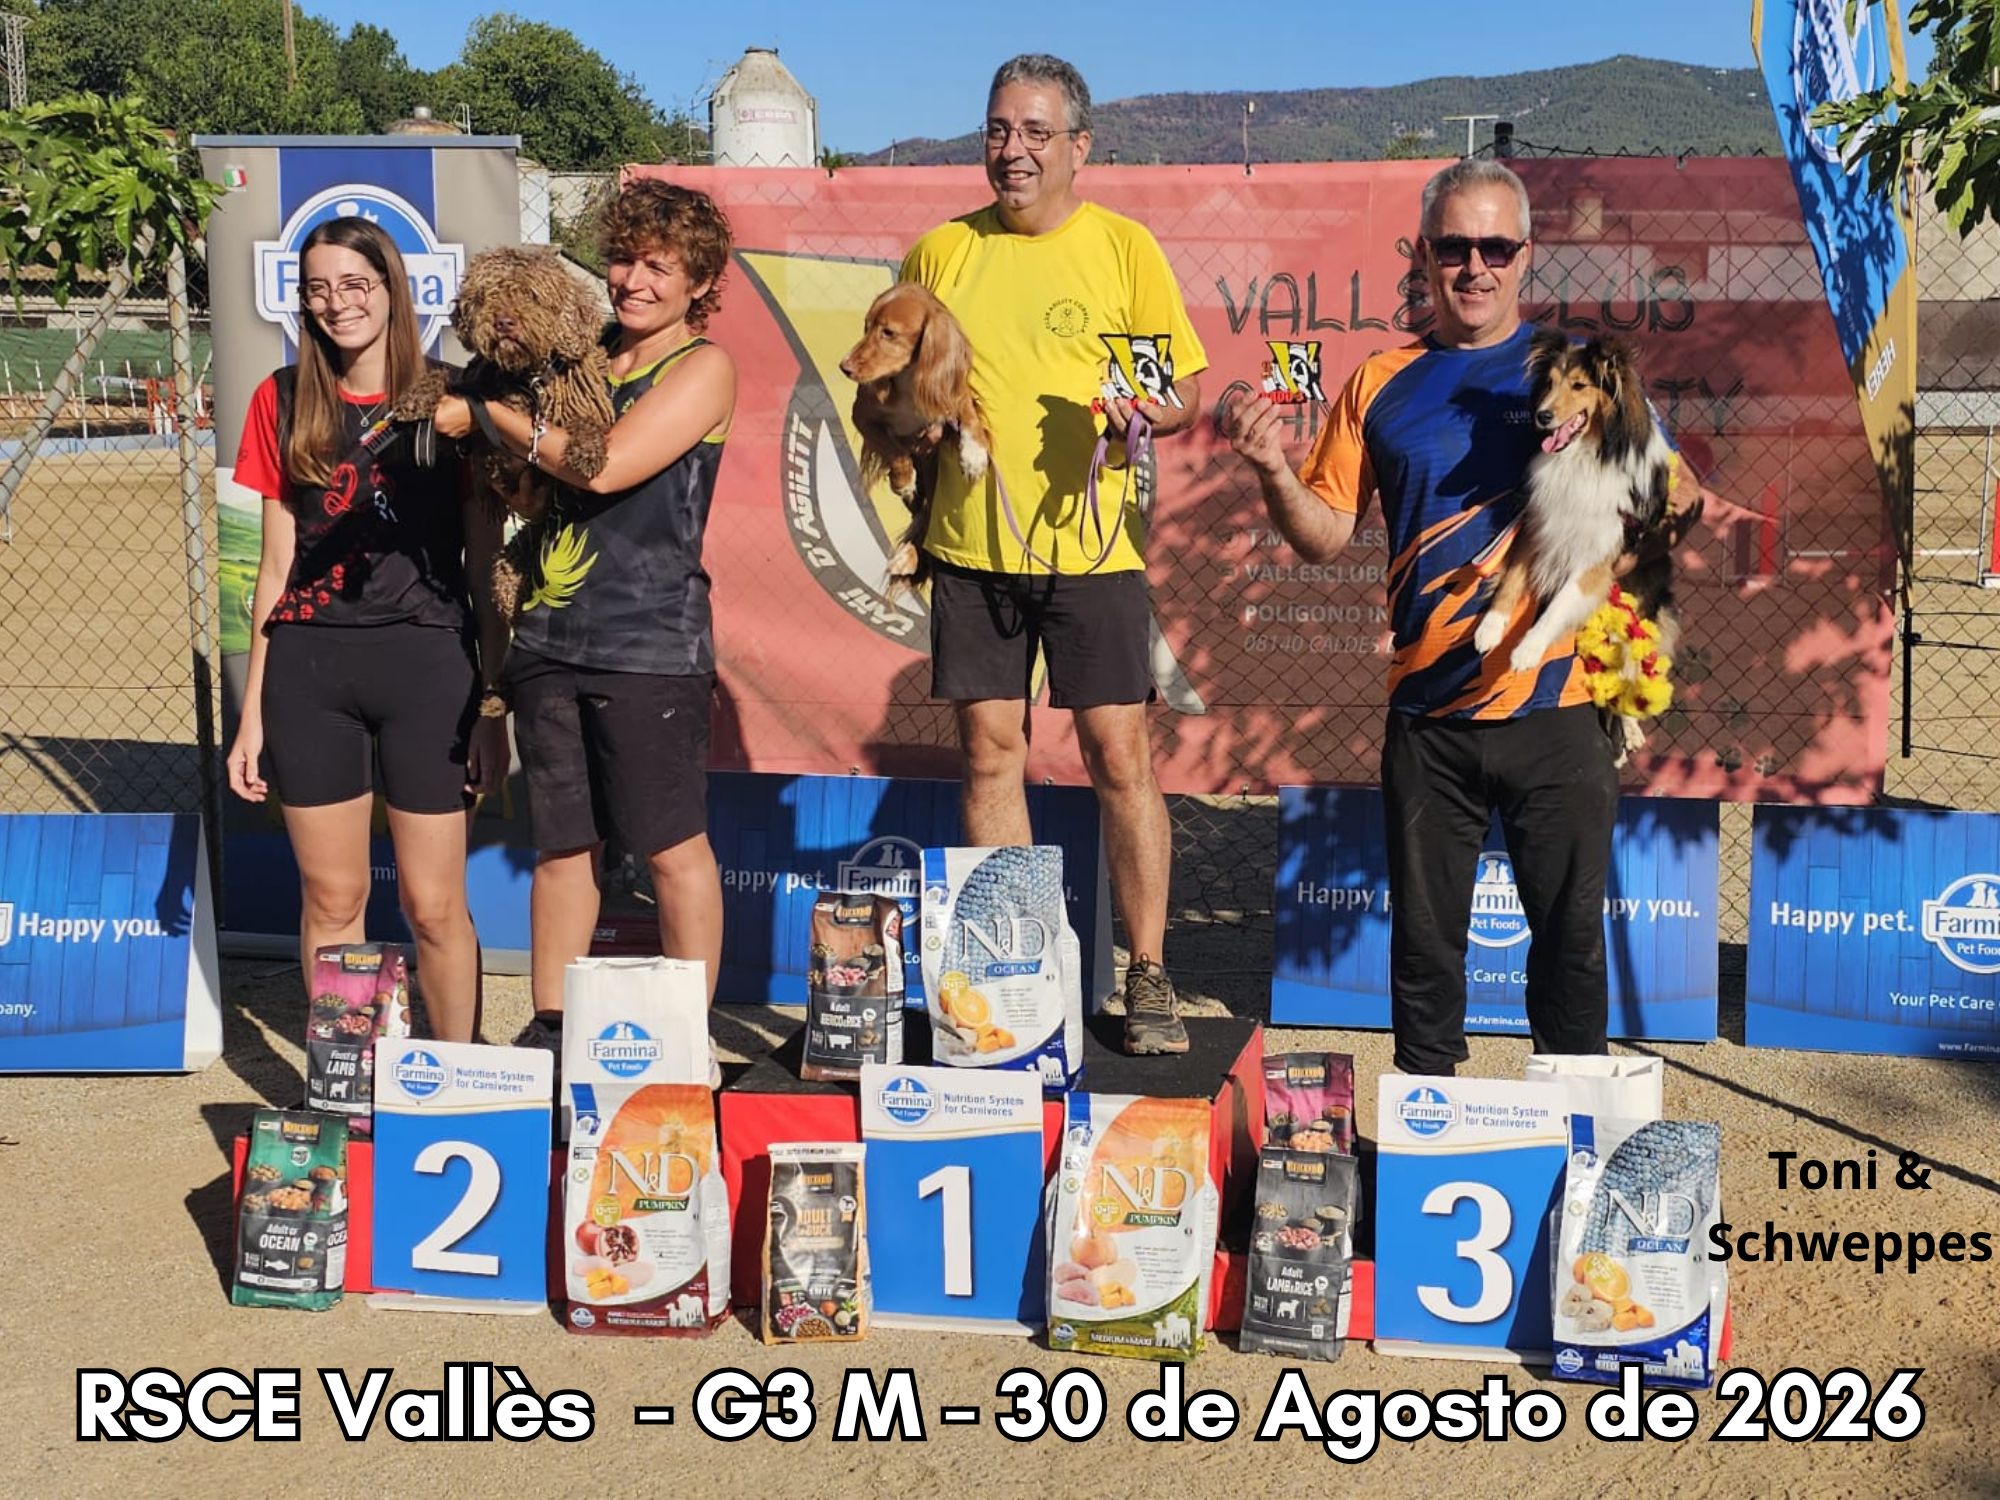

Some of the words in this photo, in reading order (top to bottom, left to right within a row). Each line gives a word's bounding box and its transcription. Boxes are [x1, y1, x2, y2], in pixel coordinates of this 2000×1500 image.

[1216, 238, 1437, 336] VALLÈ
[1525, 265, 1696, 334] LUB
[718, 864, 779, 893] appy
[786, 870, 831, 895] pet.
[848, 870, 920, 893] Farmin
[1298, 882, 1375, 912] Happy
[1647, 899, 1700, 922] you.
[1770, 902, 1854, 934] Happy
[1863, 909, 1915, 935] pet.
[19, 912, 105, 943] Happy
[112, 919, 168, 943] you.
[1490, 917, 1521, 931] Foods
[960, 917, 1046, 962] N&D
[904, 951, 920, 964] Co
[1957, 943, 1975, 955] Pet
[1978, 944, 2000, 956] Foo
[993, 964, 1037, 974] OCEAN
[1473, 969, 1506, 983] Care
[1511, 971, 1528, 984] Co
[1890, 992, 1926, 1007] Your
[1929, 994, 1956, 1008] Pet
[1960, 996, 1995, 1010] Care
[593, 1043, 658, 1058] Farmina
[326, 1061, 356, 1077] LAMB
[395, 1065, 445, 1081] Farmina
[456, 1067, 497, 1079] Nutrition
[500, 1071, 534, 1082] System
[456, 1079, 469, 1088] for
[472, 1080, 524, 1092] Carnivores
[881, 1092, 932, 1107] Farmina
[944, 1093, 986, 1104] Nutrition
[989, 1095, 1024, 1107] System
[944, 1105, 958, 1114] for
[961, 1105, 1013, 1117] Carnivores
[1399, 1103, 1453, 1119] Farmina
[1465, 1104, 1509, 1116] Nutrition
[1512, 1106, 1549, 1118] System
[1465, 1117, 1479, 1126] for
[1483, 1117, 1537, 1129] Carnivores
[607, 1151, 700, 1197] N&D
[1101, 1164, 1196, 1212] N&D
[411, 1140, 501, 1276] 2
[638, 1200, 687, 1211] PUMPKIN
[1130, 1214, 1178, 1225] PUMPKIN
[1600, 1189, 1700, 1239] N&D
[918, 1166, 973, 1296] 1
[259, 1234, 300, 1252] OCEAN
[1636, 1240, 1684, 1252] OCEAN
[1417, 1181, 1513, 1324] 3
